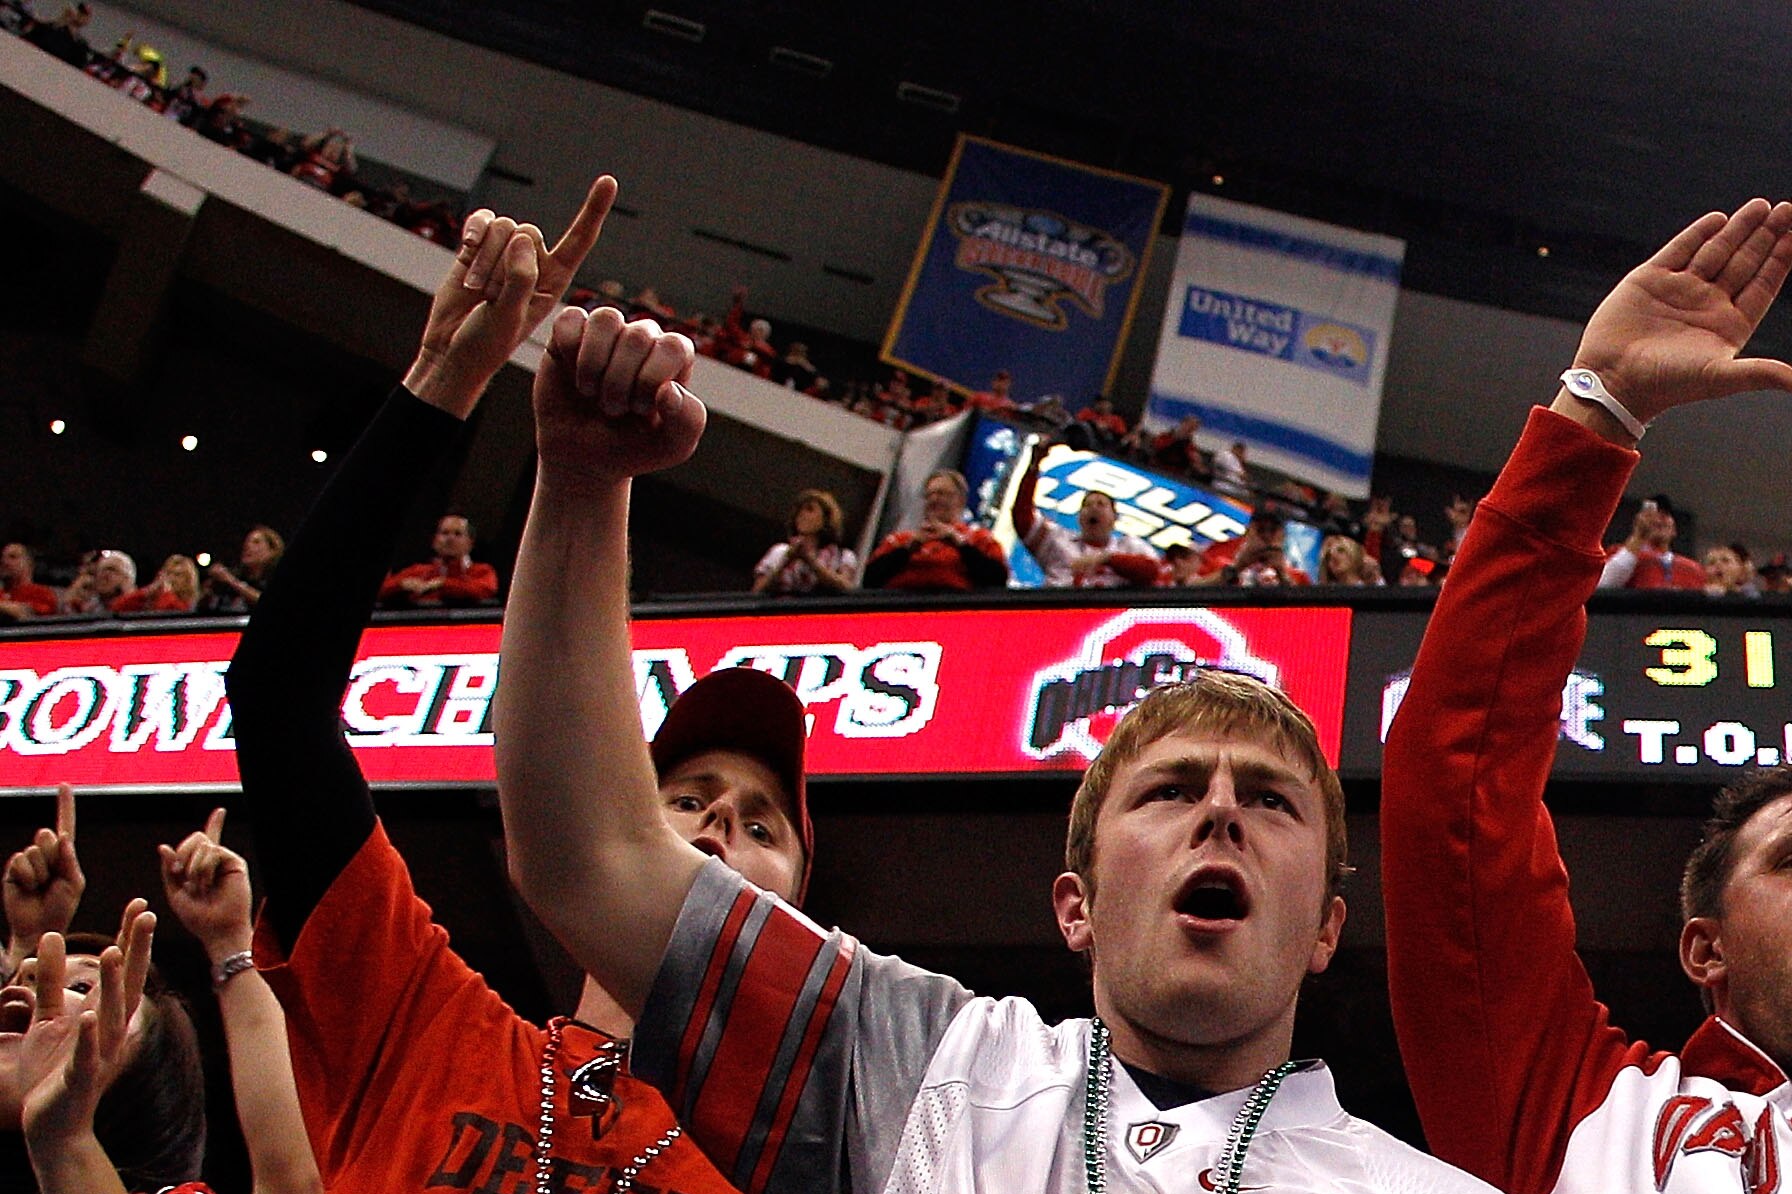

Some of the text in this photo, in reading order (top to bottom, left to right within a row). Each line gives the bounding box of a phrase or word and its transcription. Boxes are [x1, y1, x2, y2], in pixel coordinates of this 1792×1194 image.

[974, 222, 1099, 268] Allstate
[1190, 291, 1295, 332] United
[1228, 323, 1290, 355] Way
[1644, 629, 1775, 688] 31
